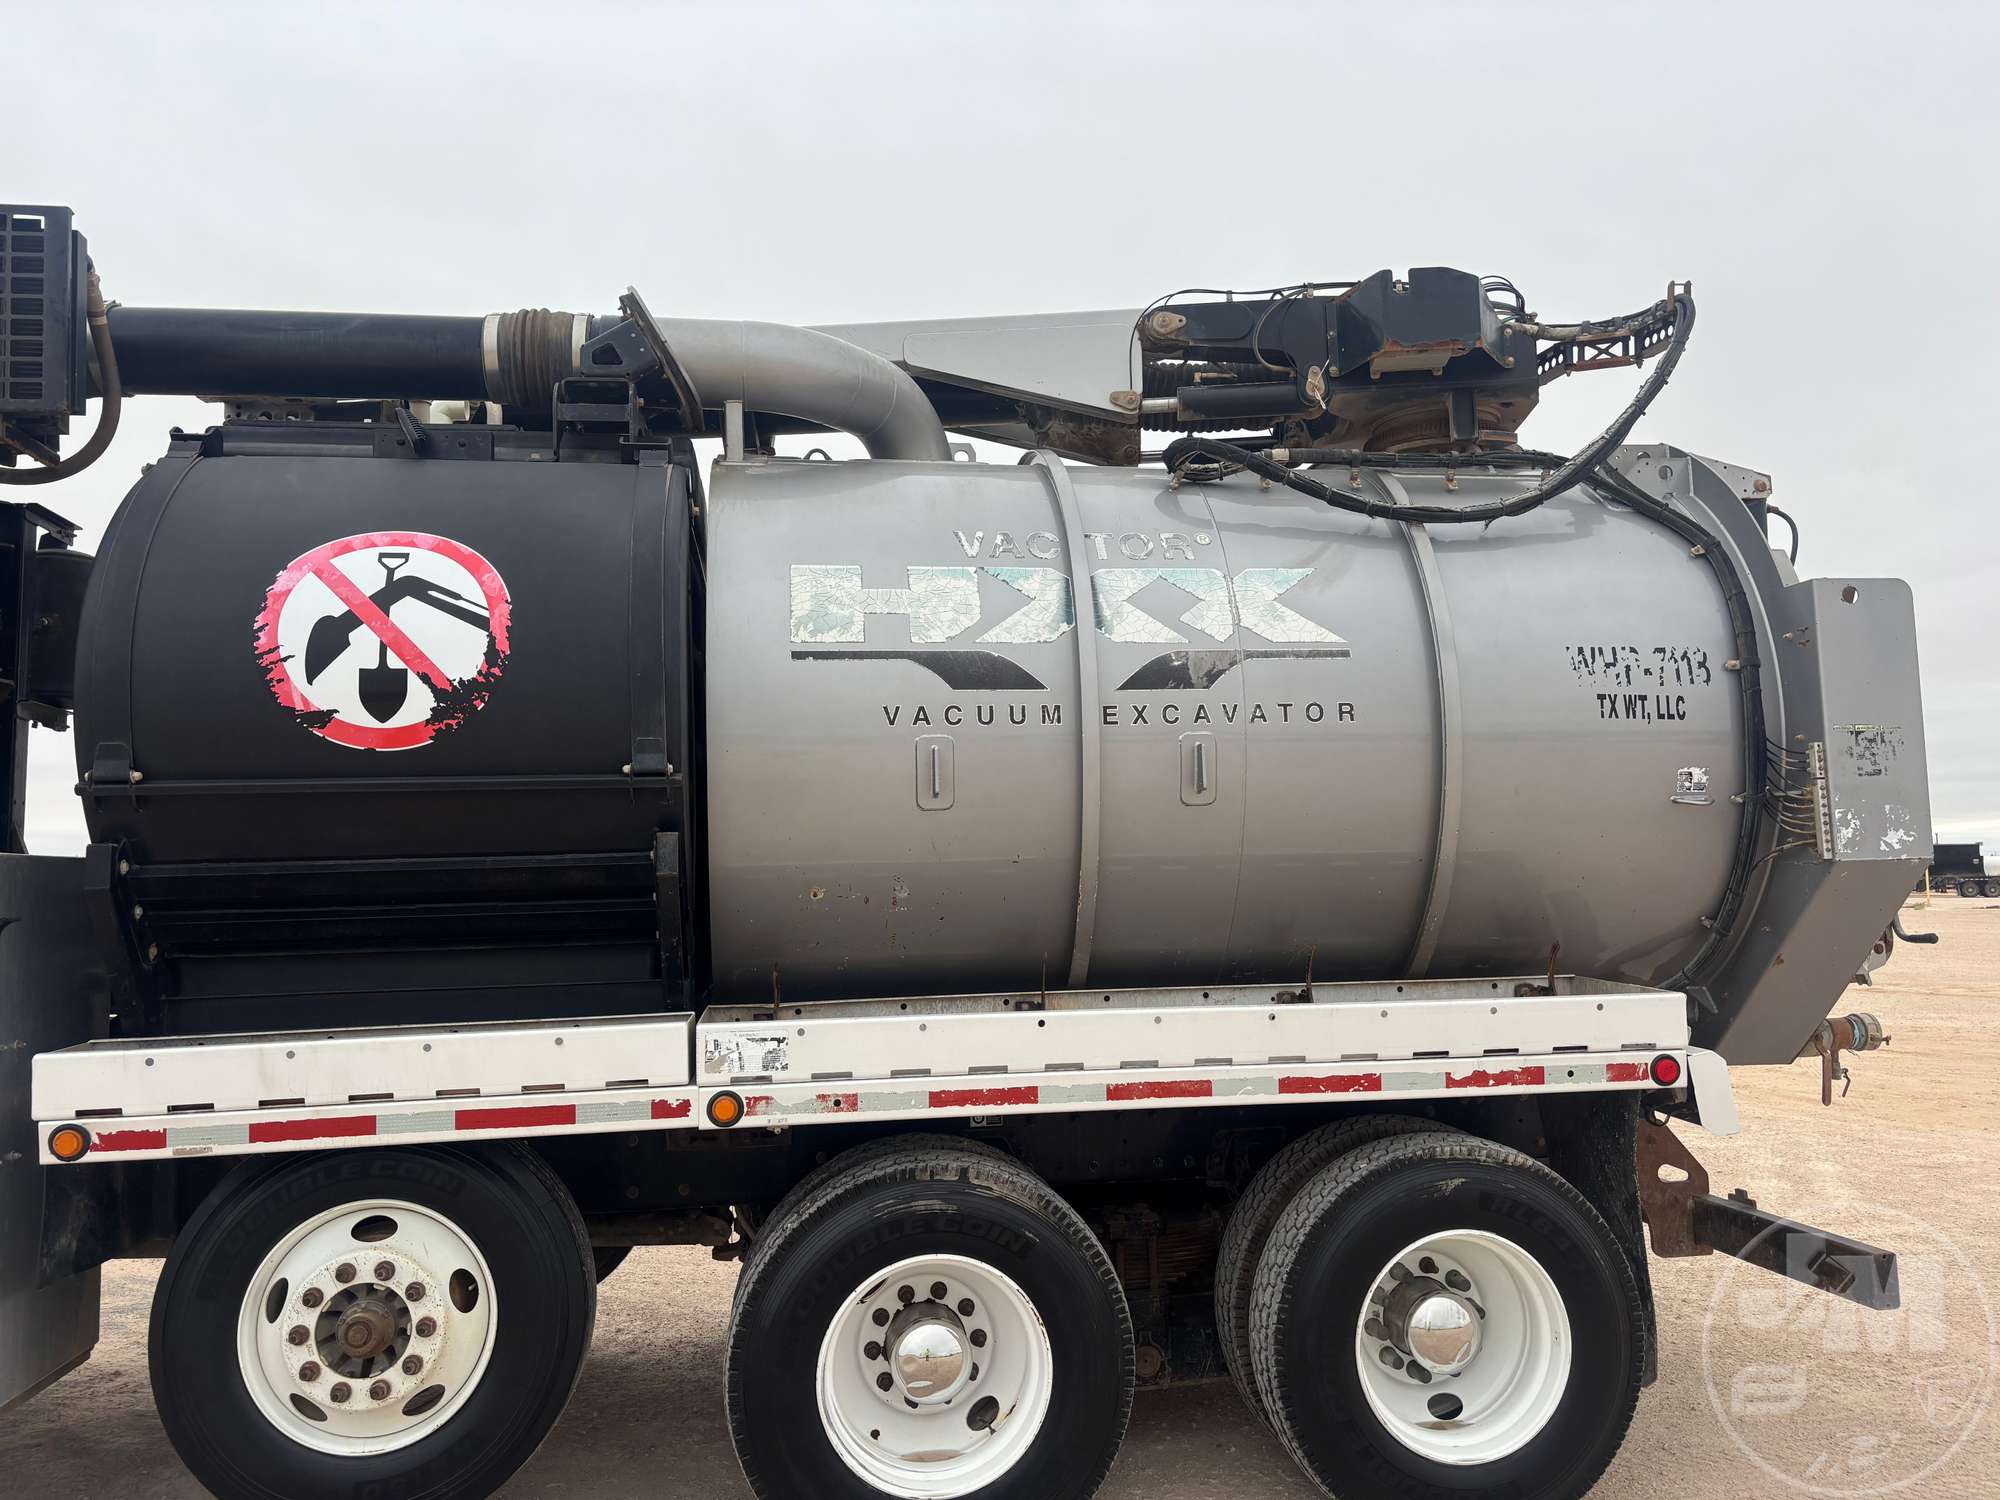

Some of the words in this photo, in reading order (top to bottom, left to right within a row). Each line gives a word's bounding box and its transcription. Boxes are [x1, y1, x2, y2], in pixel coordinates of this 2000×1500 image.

[882, 704, 1064, 727] VACUUM
[1102, 702, 1357, 726] EXCAVATOR
[1596, 693, 1619, 719] TX
[1623, 694, 1651, 725] WT,
[1656, 695, 1686, 721] LLC
